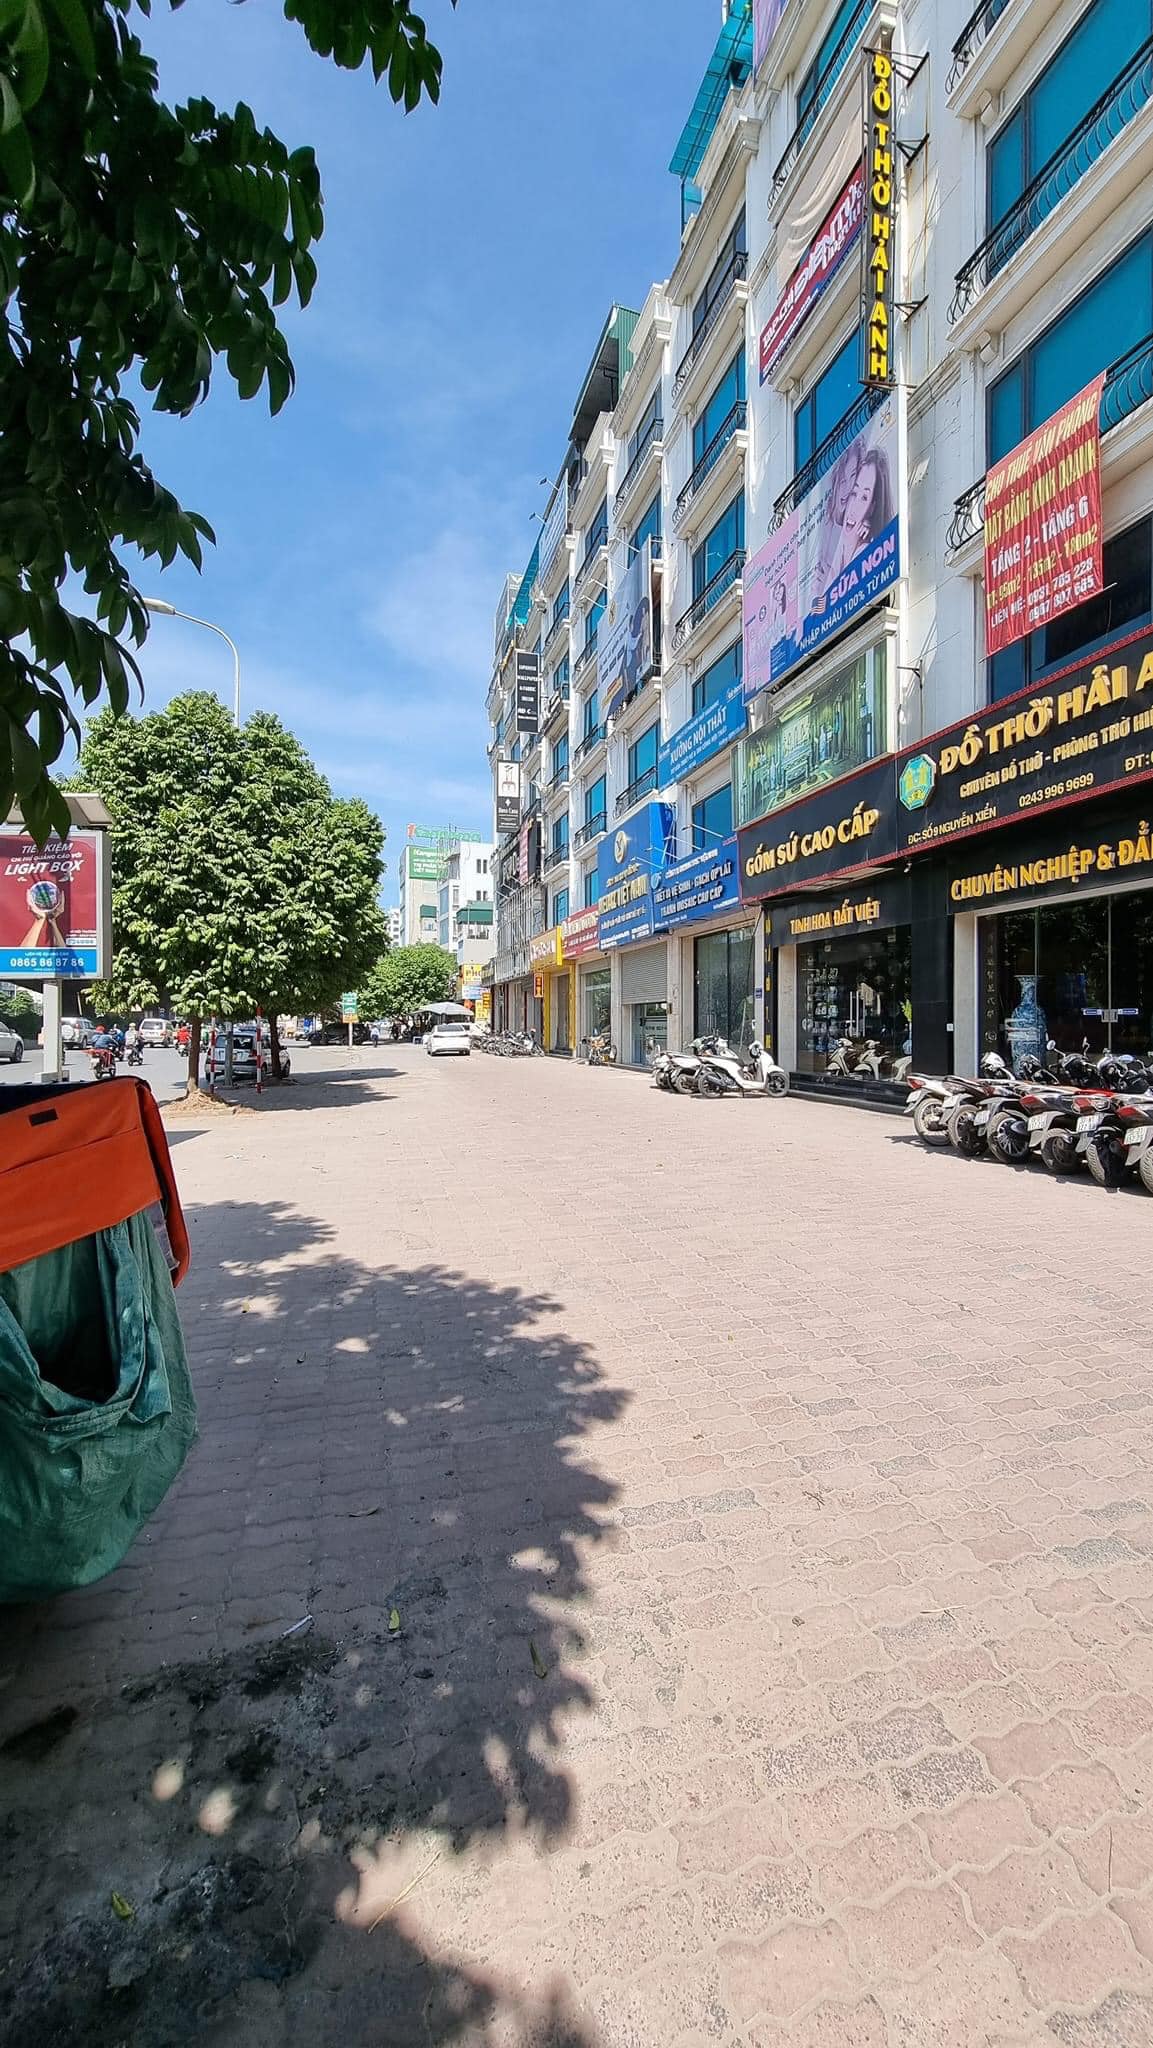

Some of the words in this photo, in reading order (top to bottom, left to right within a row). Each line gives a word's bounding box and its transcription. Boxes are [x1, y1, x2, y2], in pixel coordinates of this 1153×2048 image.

[872, 53, 892, 115] ĐỒ
[872, 122, 892, 208] THỜ
[870, 213, 892, 297] HẢI
[869, 305, 890, 380] ANH
[985, 470, 1006, 506] CHO
[1004, 488, 1030, 533] BẰNG
[1058, 436, 1097, 492] DOANH
[991, 541, 1021, 578] TẦNG
[1024, 535, 1031, 556] 2
[1041, 503, 1075, 543] TẦNG
[1078, 495, 1089, 519] 6
[829, 573, 859, 606] SỮA
[861, 534, 896, 577] NON
[800, 629, 820, 650] NHẬP
[844, 592, 866, 616] 100%
[866, 578, 879, 596] TỪ
[880, 561, 896, 584] MỸ
[991, 603, 1009, 628] LIÊN
[707, 704, 727, 735] THẤT
[939, 723, 984, 776] ĐỒ
[985, 695, 1054, 755] THỜ
[1057, 664, 1129, 725] HẢI
[959, 771, 1000, 799] CHUYÊN
[1000, 758, 1018, 783] ĐỒ
[1018, 750, 1045, 776] THỜ
[1052, 736, 1099, 763] PHÒNG
[1018, 787, 1044, 808] 0243
[1044, 780, 1065, 801] 996
[1065, 772, 1095, 793] 9699
[44, 842, 74, 853] KIỆM
[745, 843, 776, 878] GỐM
[776, 831, 800, 866] SỨ
[800, 825, 836, 857] CAO
[837, 800, 880, 843] CẤP
[921, 822, 934, 840] SỐ
[933, 826, 939, 837] 9
[938, 811, 974, 835] NGUYỄN
[975, 801, 997, 823] XIỂN
[4, 862, 49, 876] LIGHT
[50, 860, 85, 873] BOX
[709, 882, 723, 900] CẤP
[950, 863, 1018, 901] CHUYÊN
[1019, 844, 1096, 884] NGHIỆP
[1096, 844, 1116, 870] &
[1116, 819, 1153, 867] ĐẲ
[789, 916, 812, 935] TINH
[812, 911, 832, 933] HOA
[834, 898, 854, 926] ĐẤT
[854, 895, 882, 925] VIỆT
[10, 958, 37, 967] 0865
[39, 958, 53, 967] 86
[55, 958, 68, 967] 87
